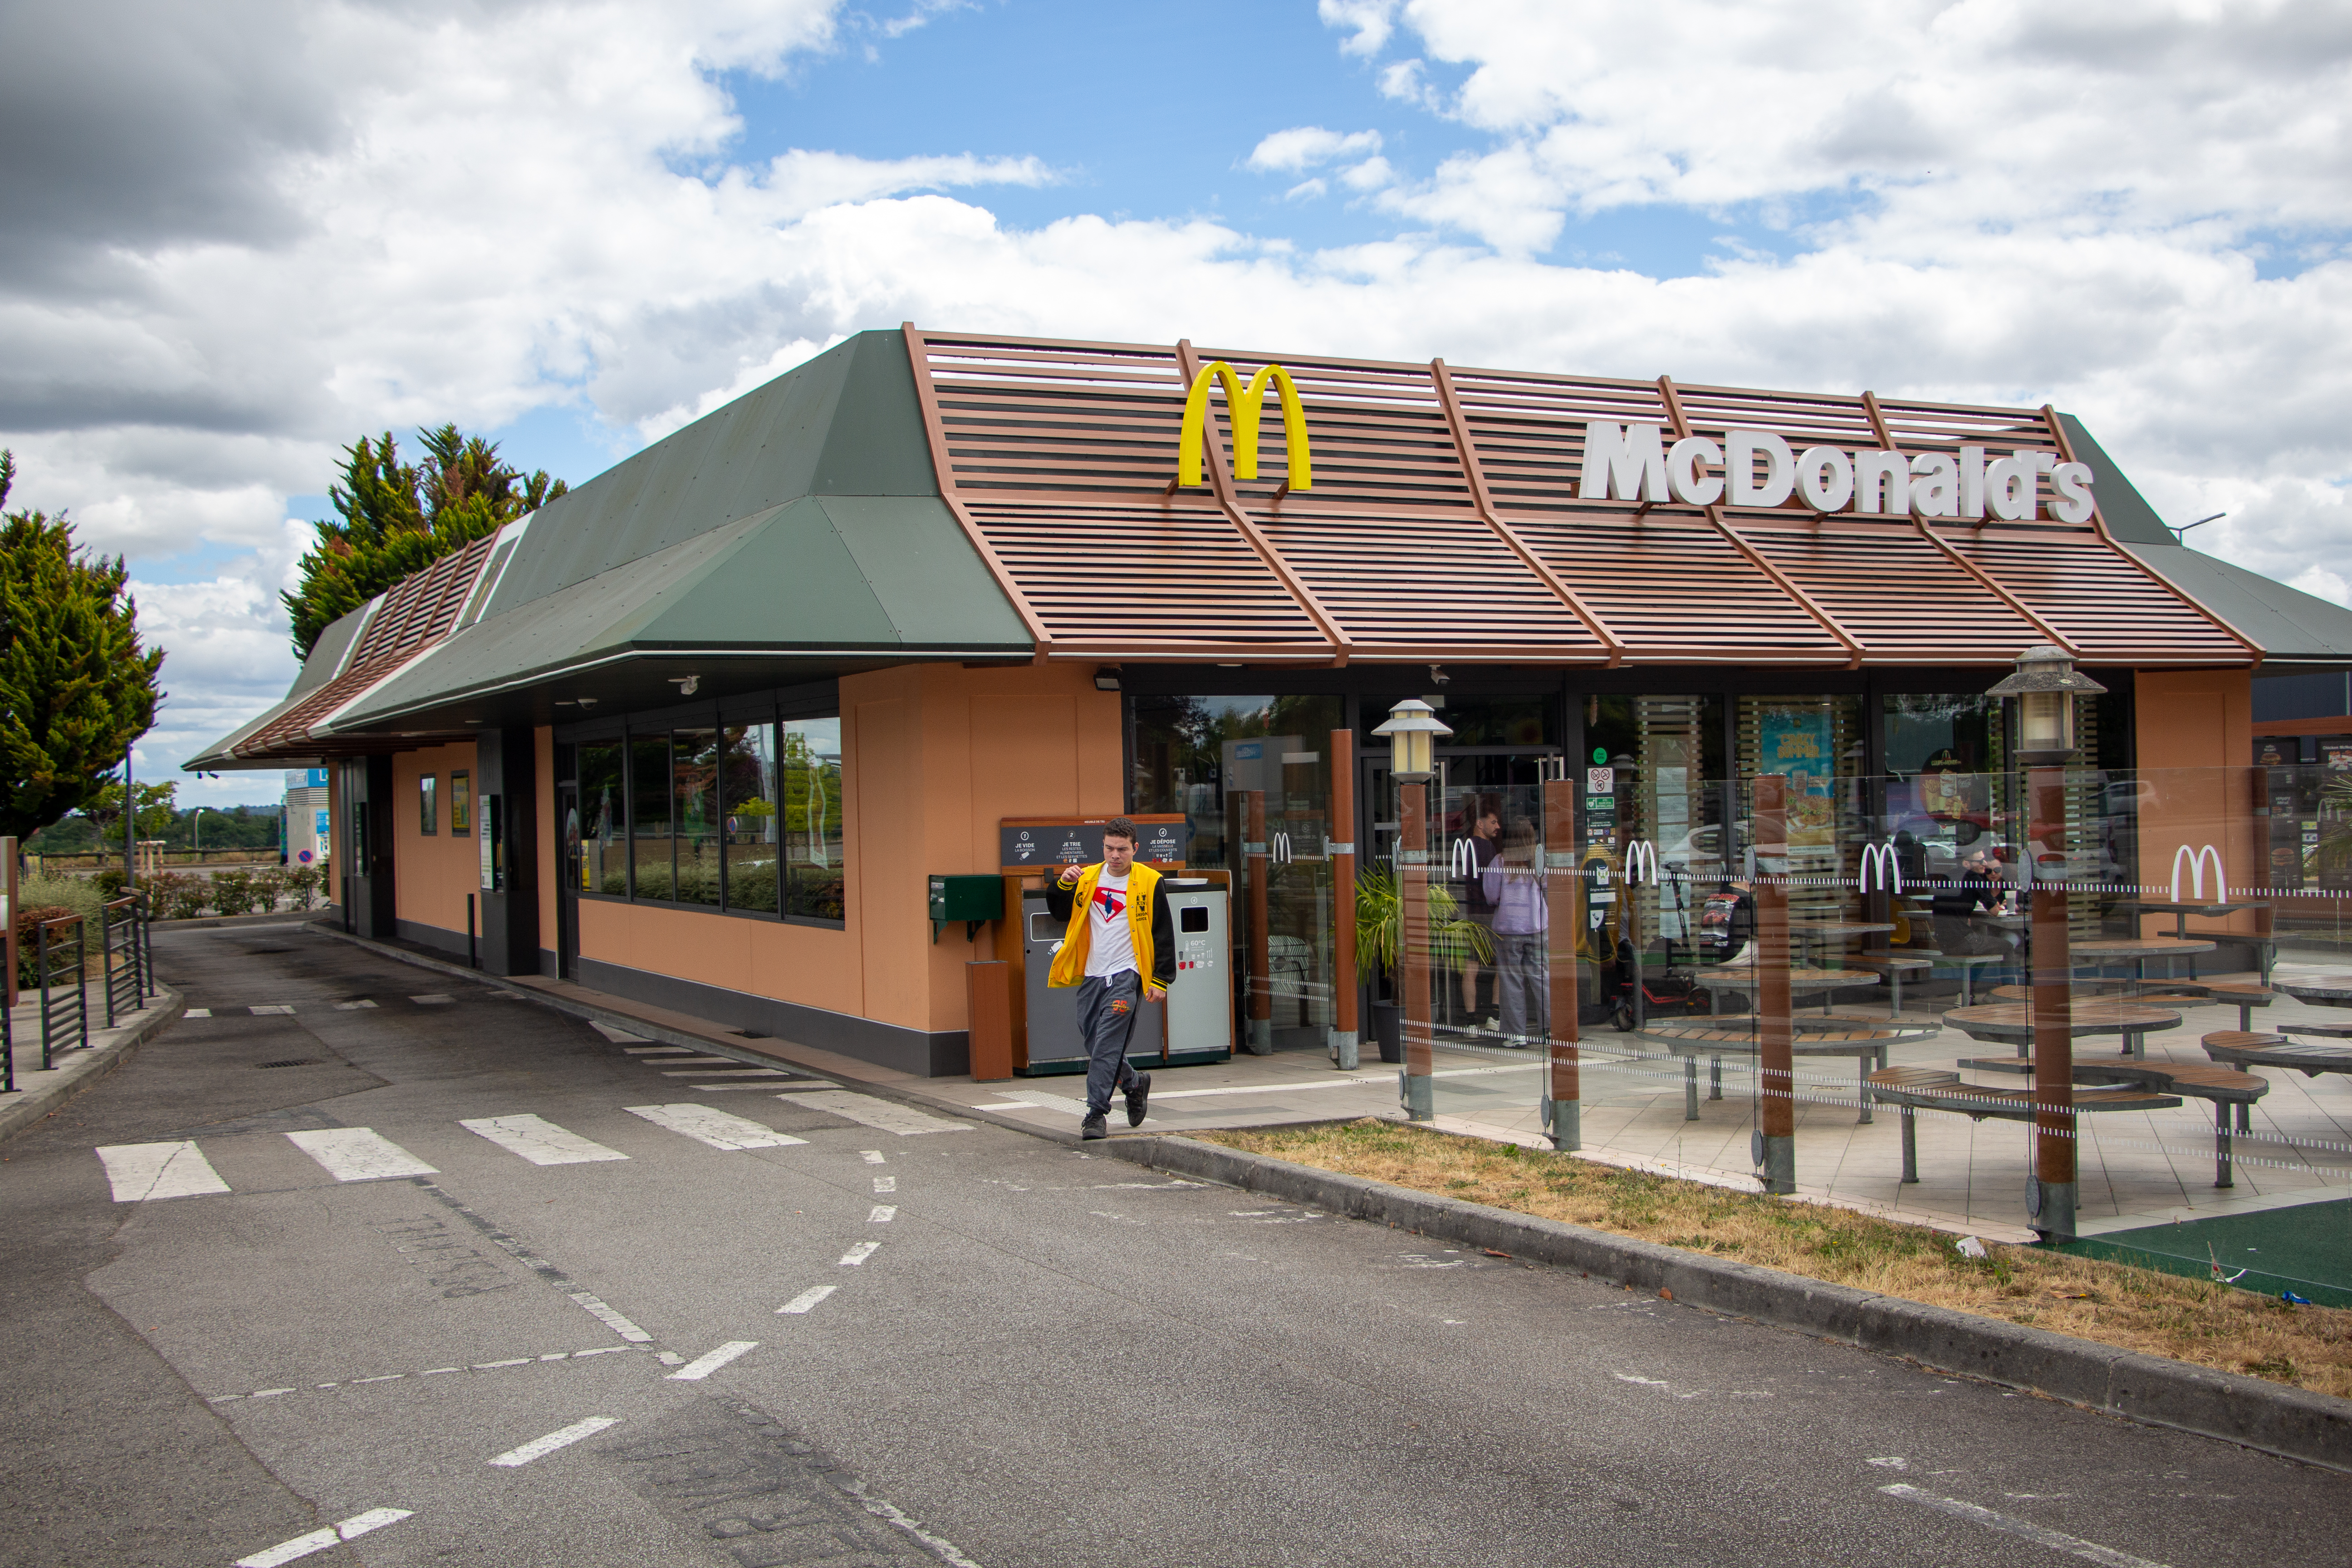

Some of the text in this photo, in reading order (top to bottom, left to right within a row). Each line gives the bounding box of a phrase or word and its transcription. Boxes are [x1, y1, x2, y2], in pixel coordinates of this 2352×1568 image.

[1578, 420, 2094, 524] McDonald's
[1780, 734, 1815, 746] CRAZY
[1777, 745, 1819, 759] SUMMER
